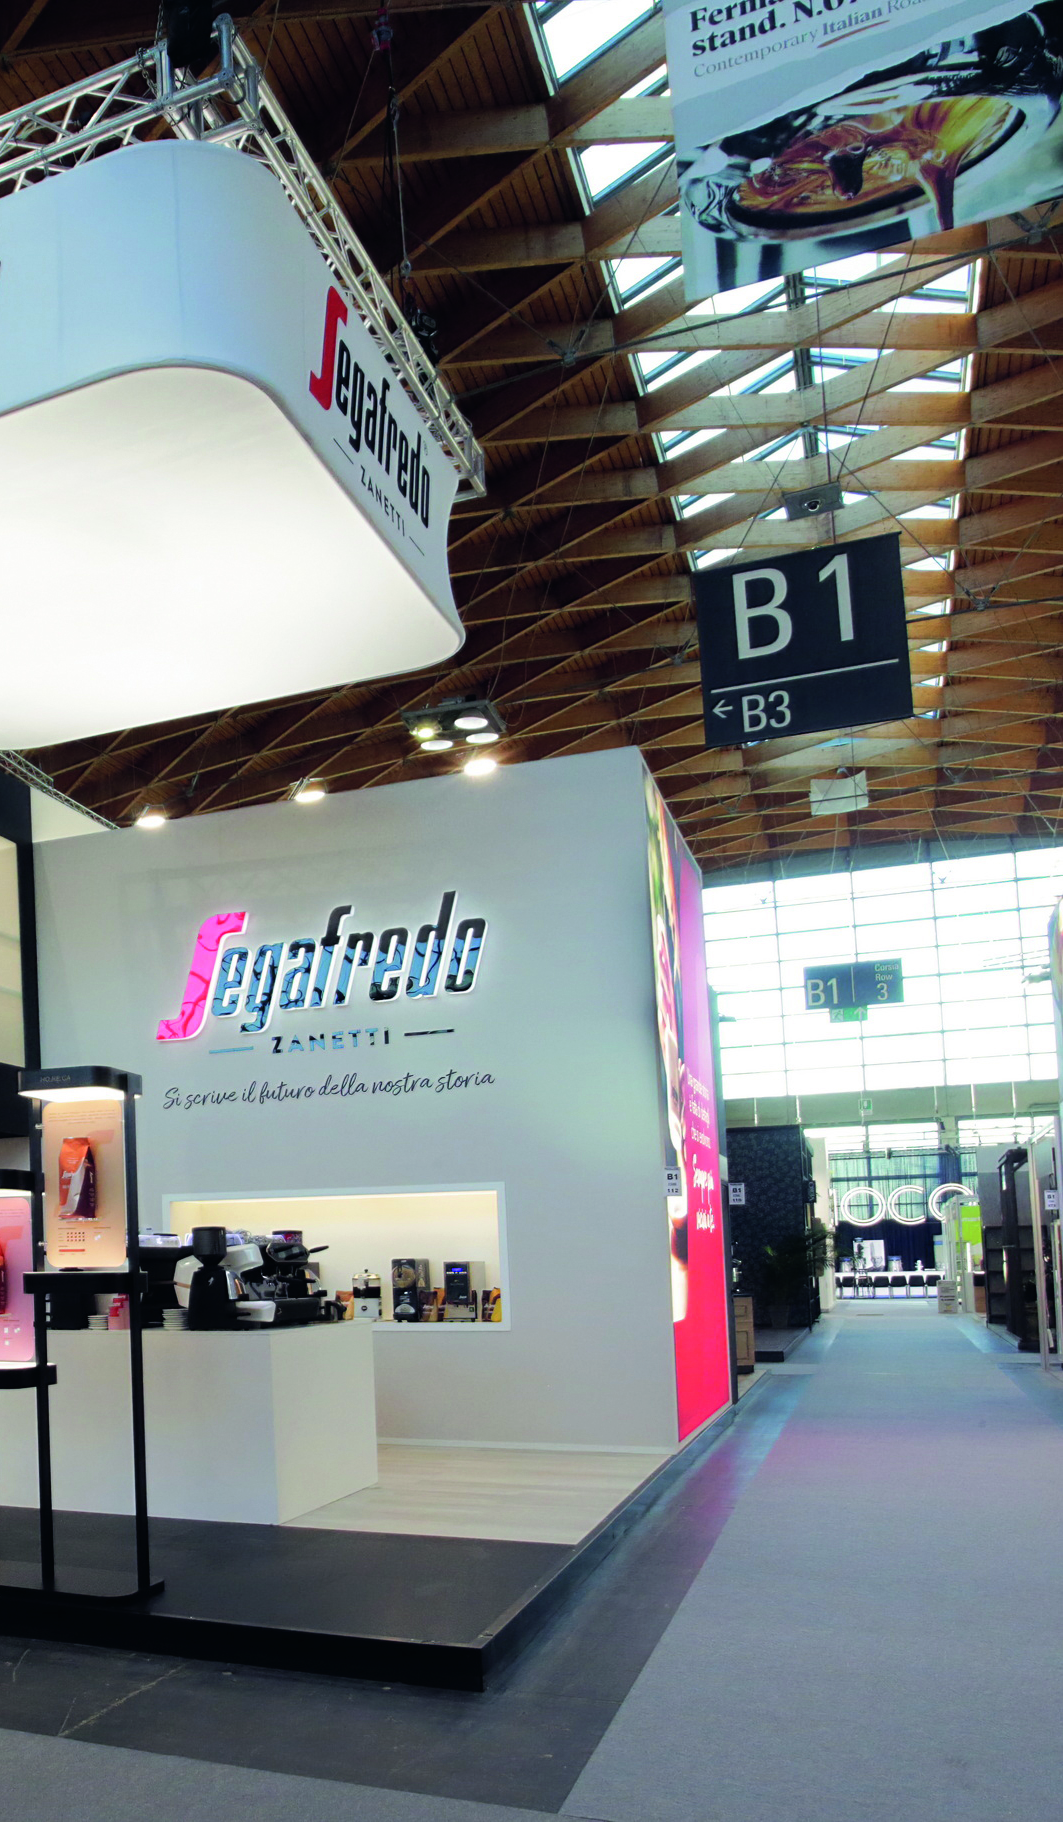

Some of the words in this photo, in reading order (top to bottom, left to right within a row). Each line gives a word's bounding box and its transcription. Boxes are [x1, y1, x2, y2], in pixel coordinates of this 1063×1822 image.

[690, 0, 783, 32] Ferm
[692, 8, 786, 57] stand.
[693, 28, 819, 78] Contemporary
[822, 7, 883, 36] Italian
[309, 285, 431, 529] Segafredo
[360, 464, 405, 537] ZANETTI
[741, 690, 791, 733] B3
[156, 889, 489, 1042] Segafredo
[874, 963, 899, 972] Corsia
[875, 973, 894, 981] Row
[806, 977, 839, 1006] B1
[876, 982, 889, 1001] 3
[271, 1027, 390, 1054] ZANETTI
[163, 1087, 181, 1110] Si
[184, 1090, 238, 1110] scrive
[241, 1081, 256, 1103] il
[259, 1081, 315, 1105] futuro
[318, 1072, 368, 1097] della
[371, 1072, 434, 1096] nostra
[435, 1069, 496, 1093] storia
